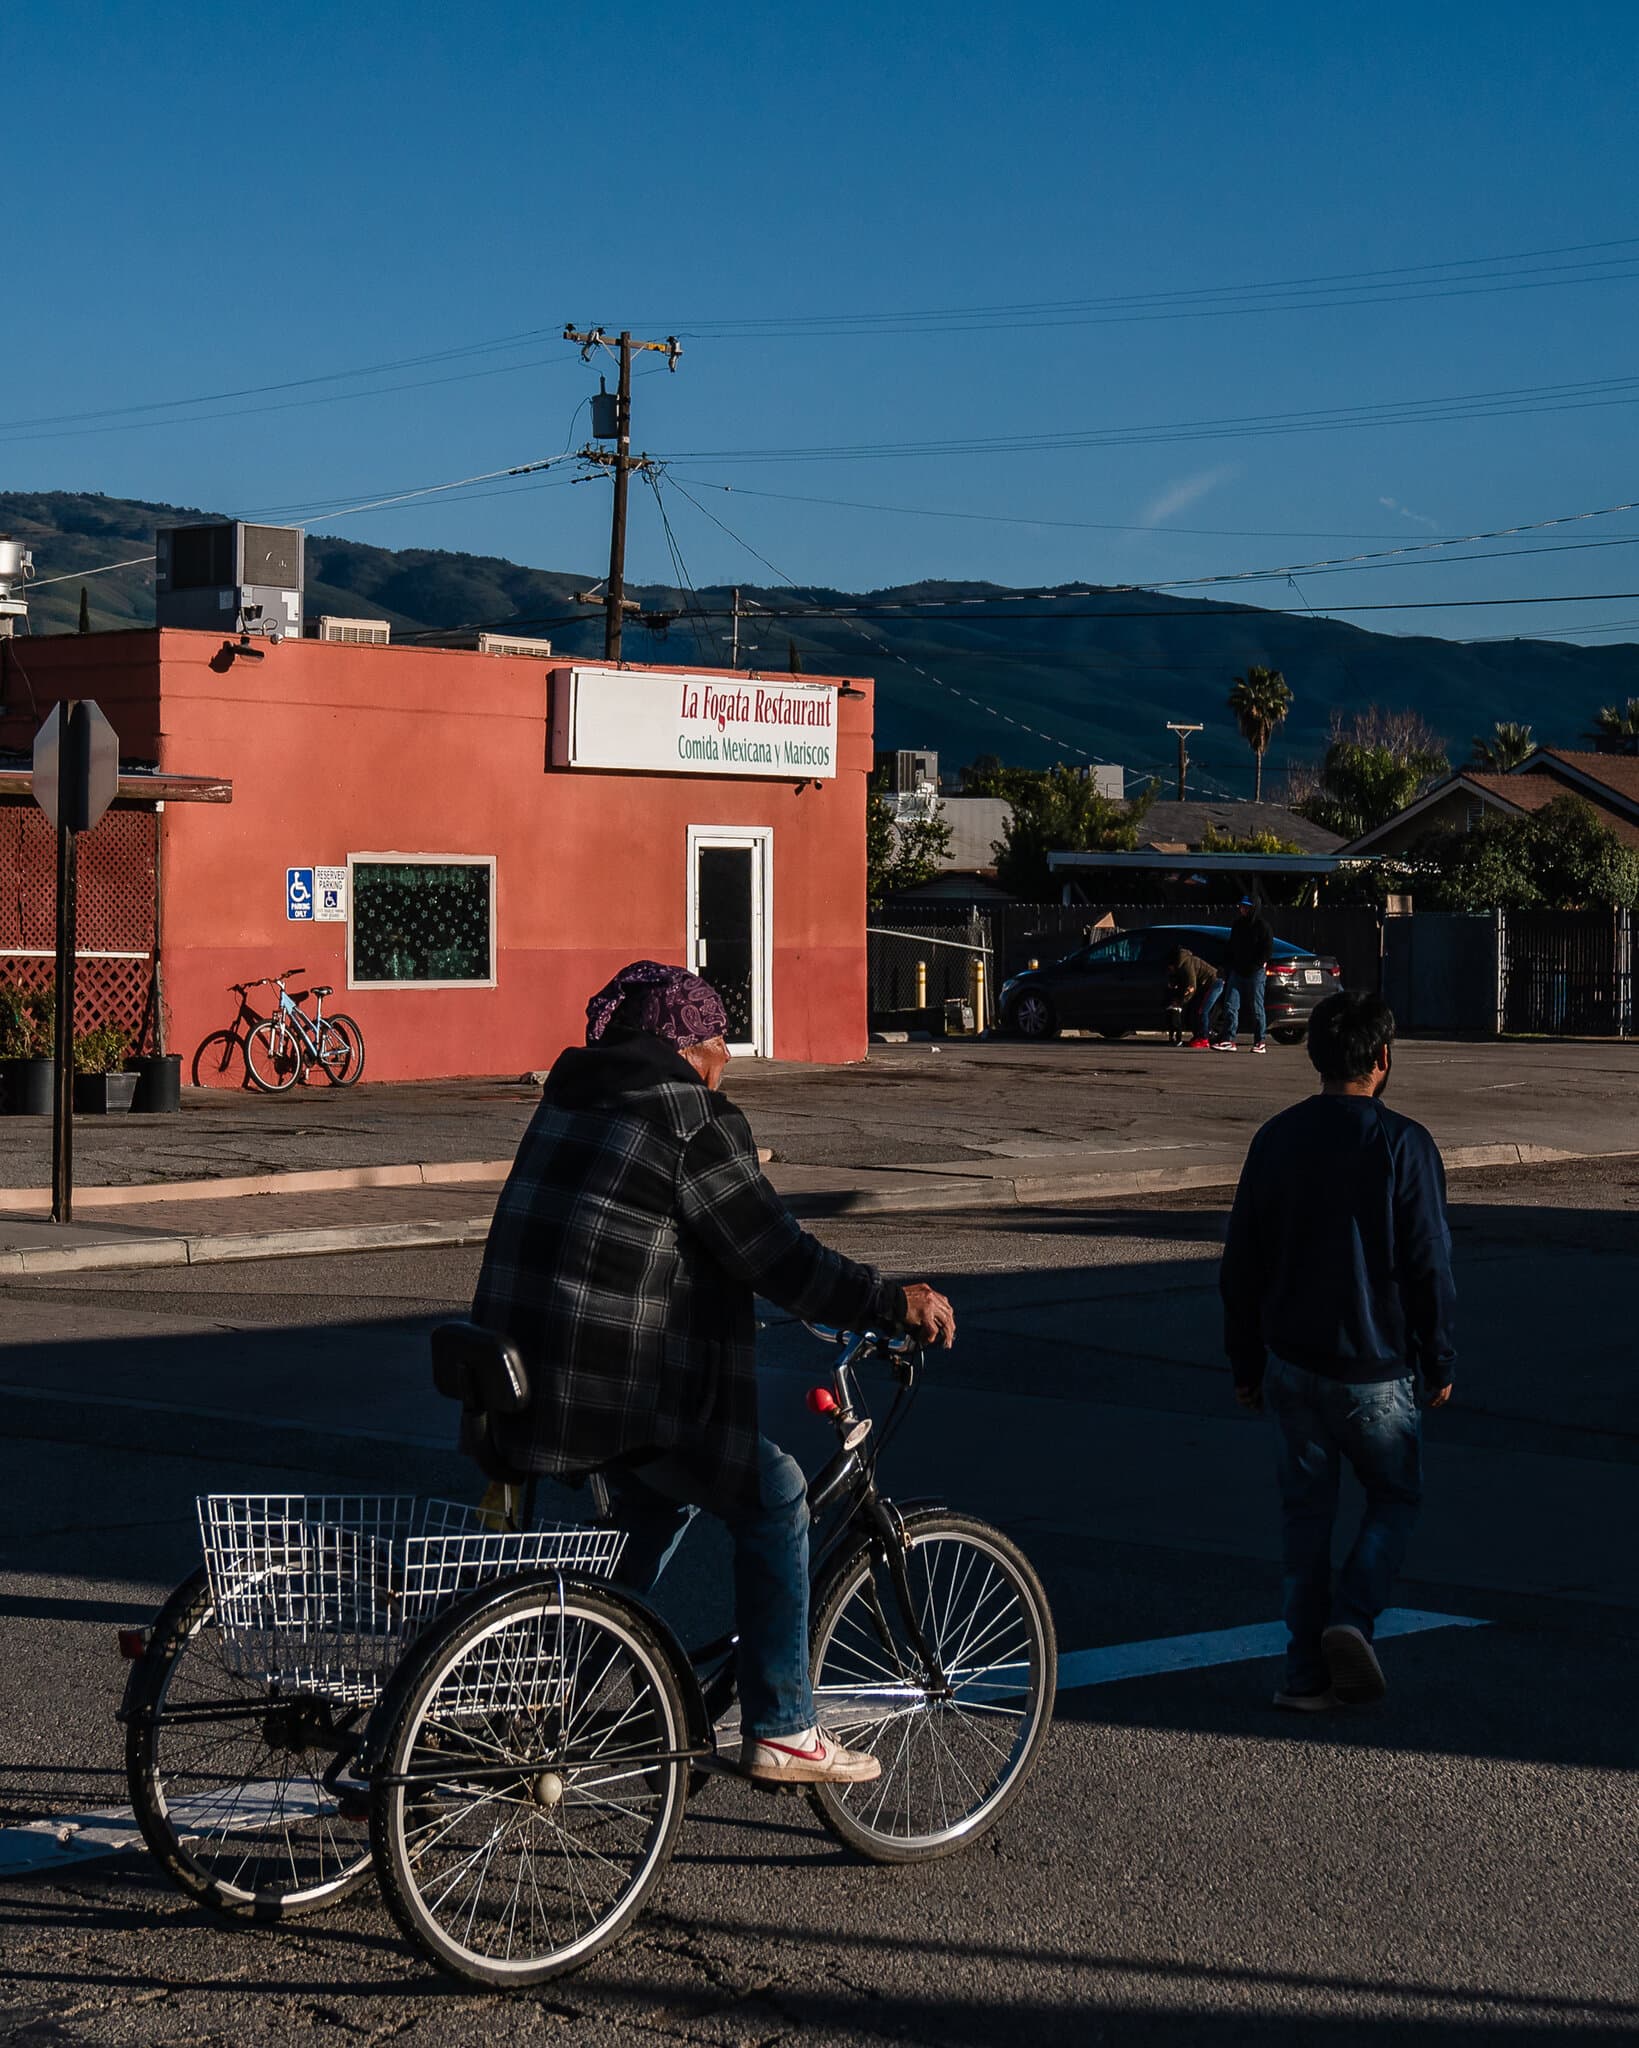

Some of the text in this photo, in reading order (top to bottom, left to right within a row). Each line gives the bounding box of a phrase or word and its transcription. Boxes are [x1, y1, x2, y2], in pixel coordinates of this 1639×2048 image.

[681, 684, 831, 732] La Fogata Restaurant
[678, 734, 719, 761] Comida
[722, 738, 772, 763] Mexicana
[784, 741, 830, 766] Mariscos
[317, 870, 345, 880] RESERVED
[319, 880, 342, 890] PARKING
